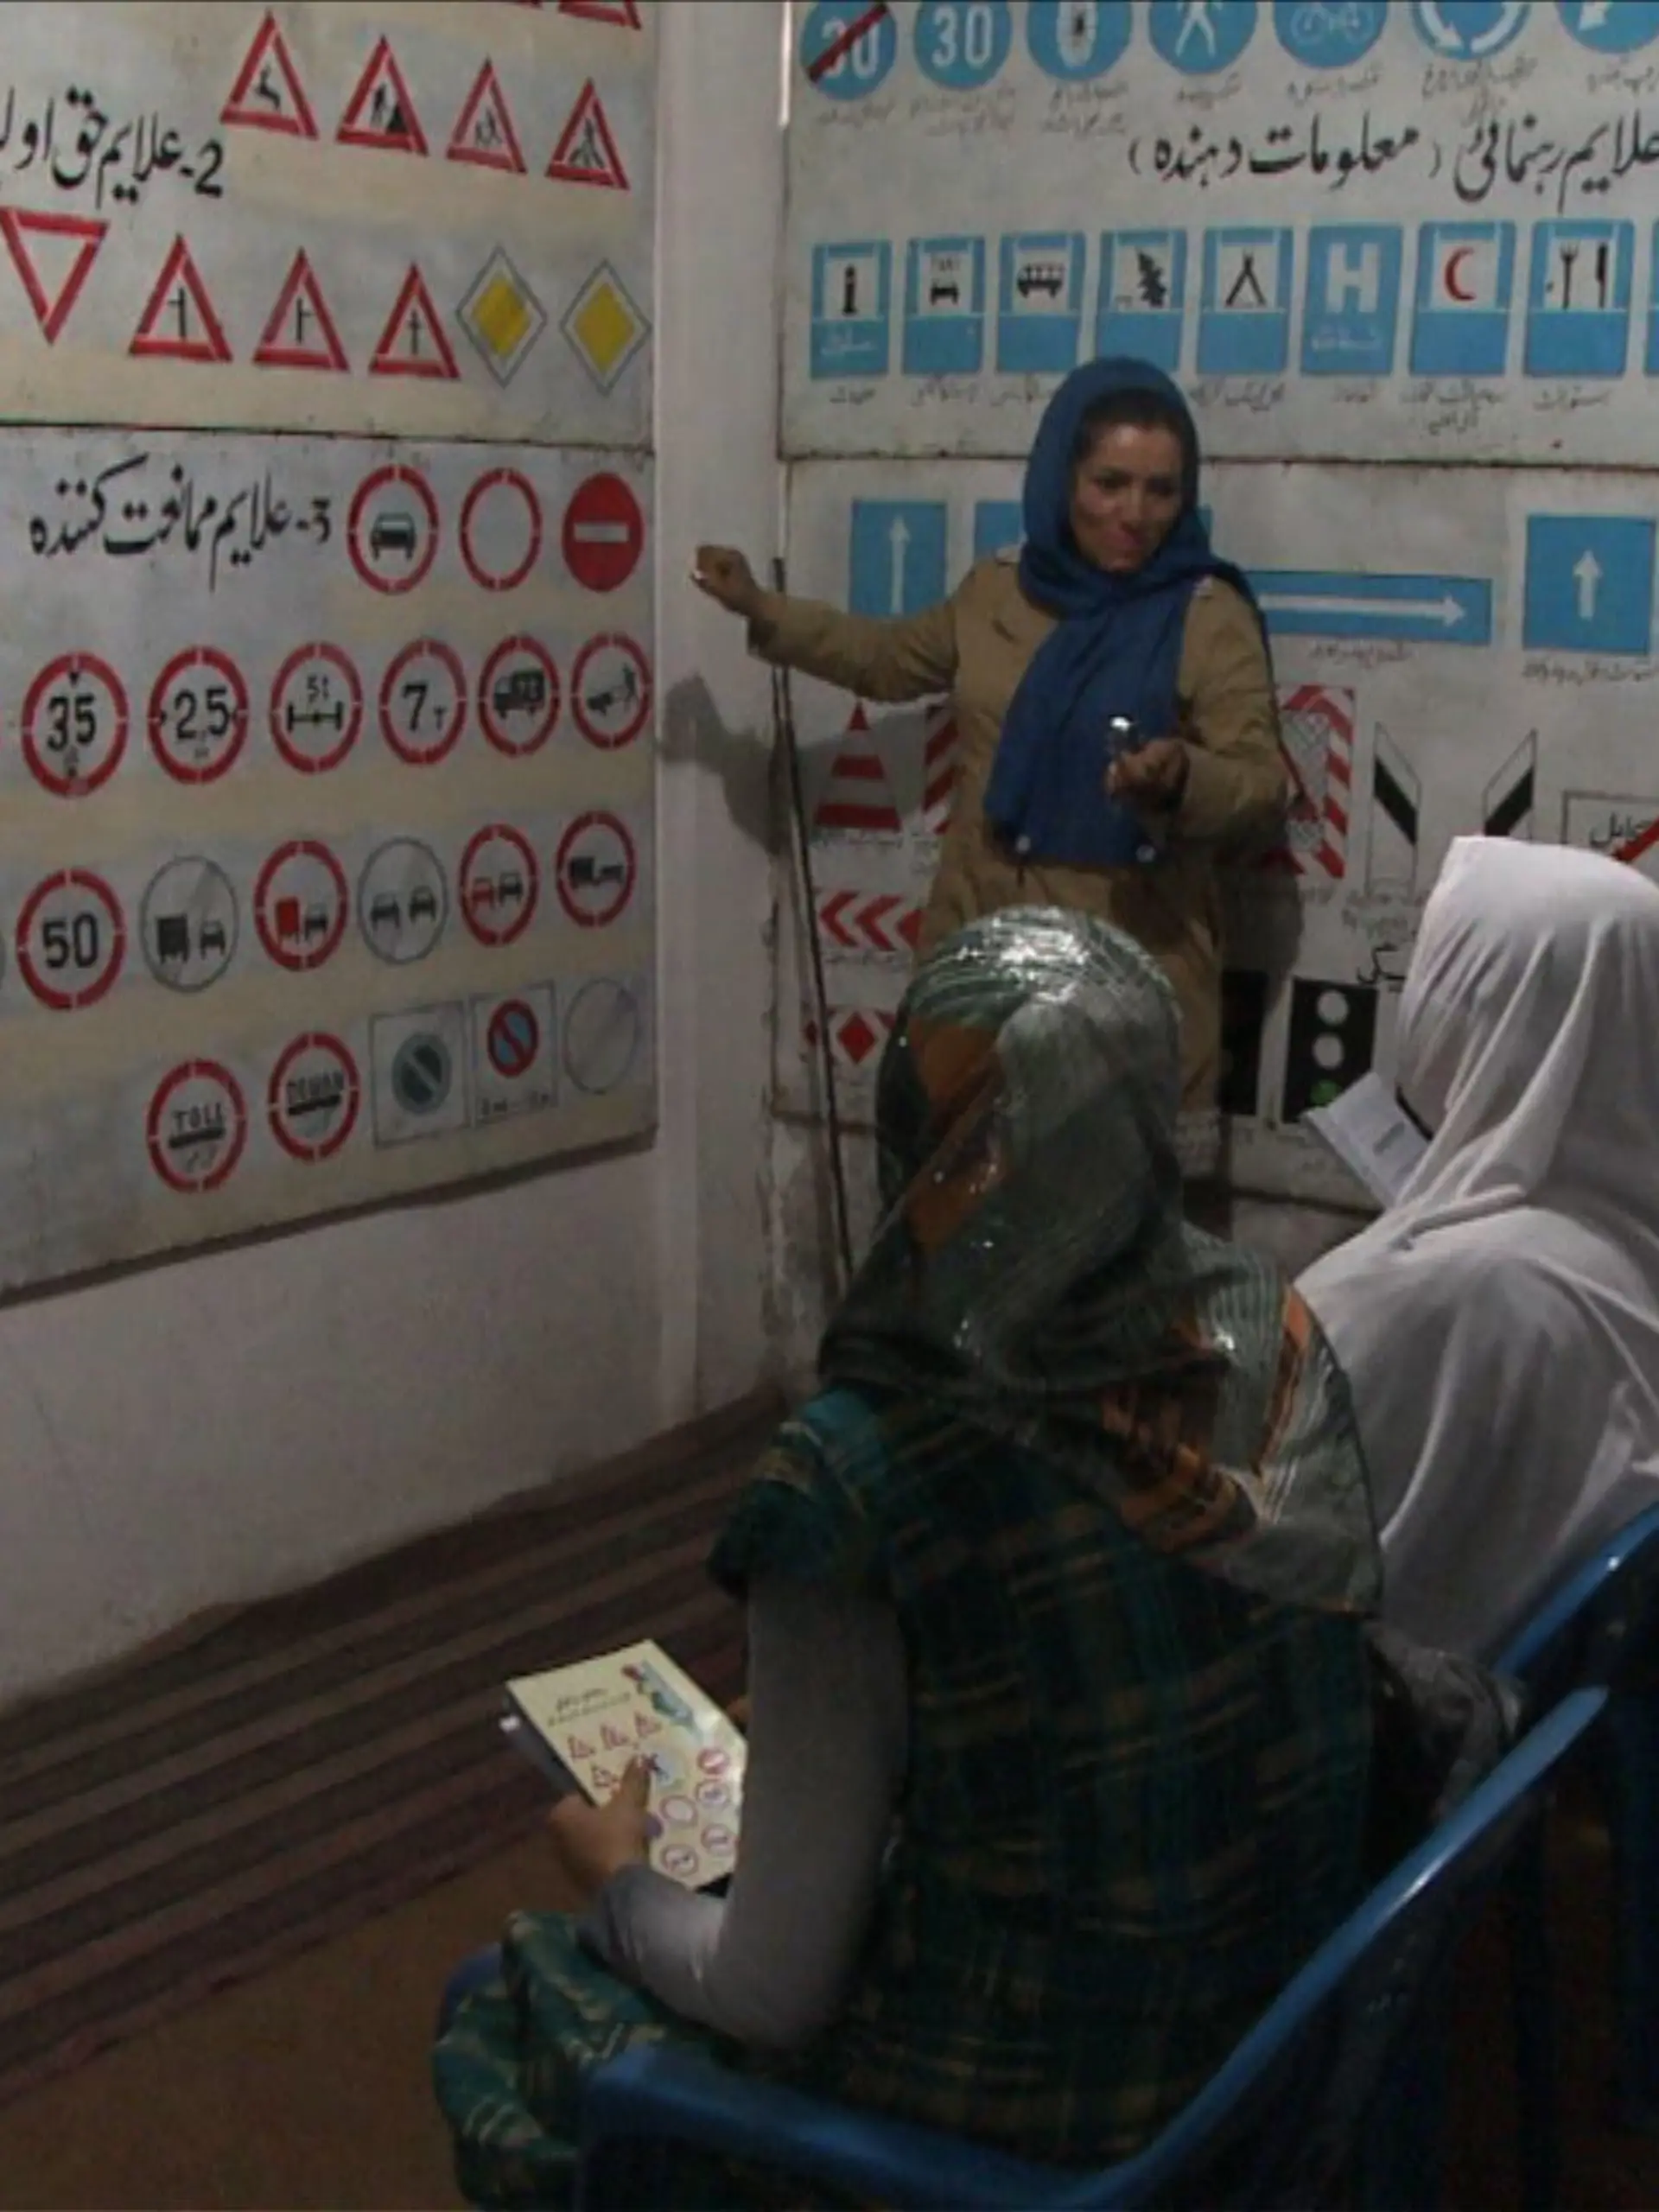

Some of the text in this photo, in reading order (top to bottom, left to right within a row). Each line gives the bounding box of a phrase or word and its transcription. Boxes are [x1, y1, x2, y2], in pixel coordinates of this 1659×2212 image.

[822, 16, 880, 79] 30
[931, 5, 994, 67] 30
[1328, 242, 1379, 314] H
[42, 912, 99, 969] 50
